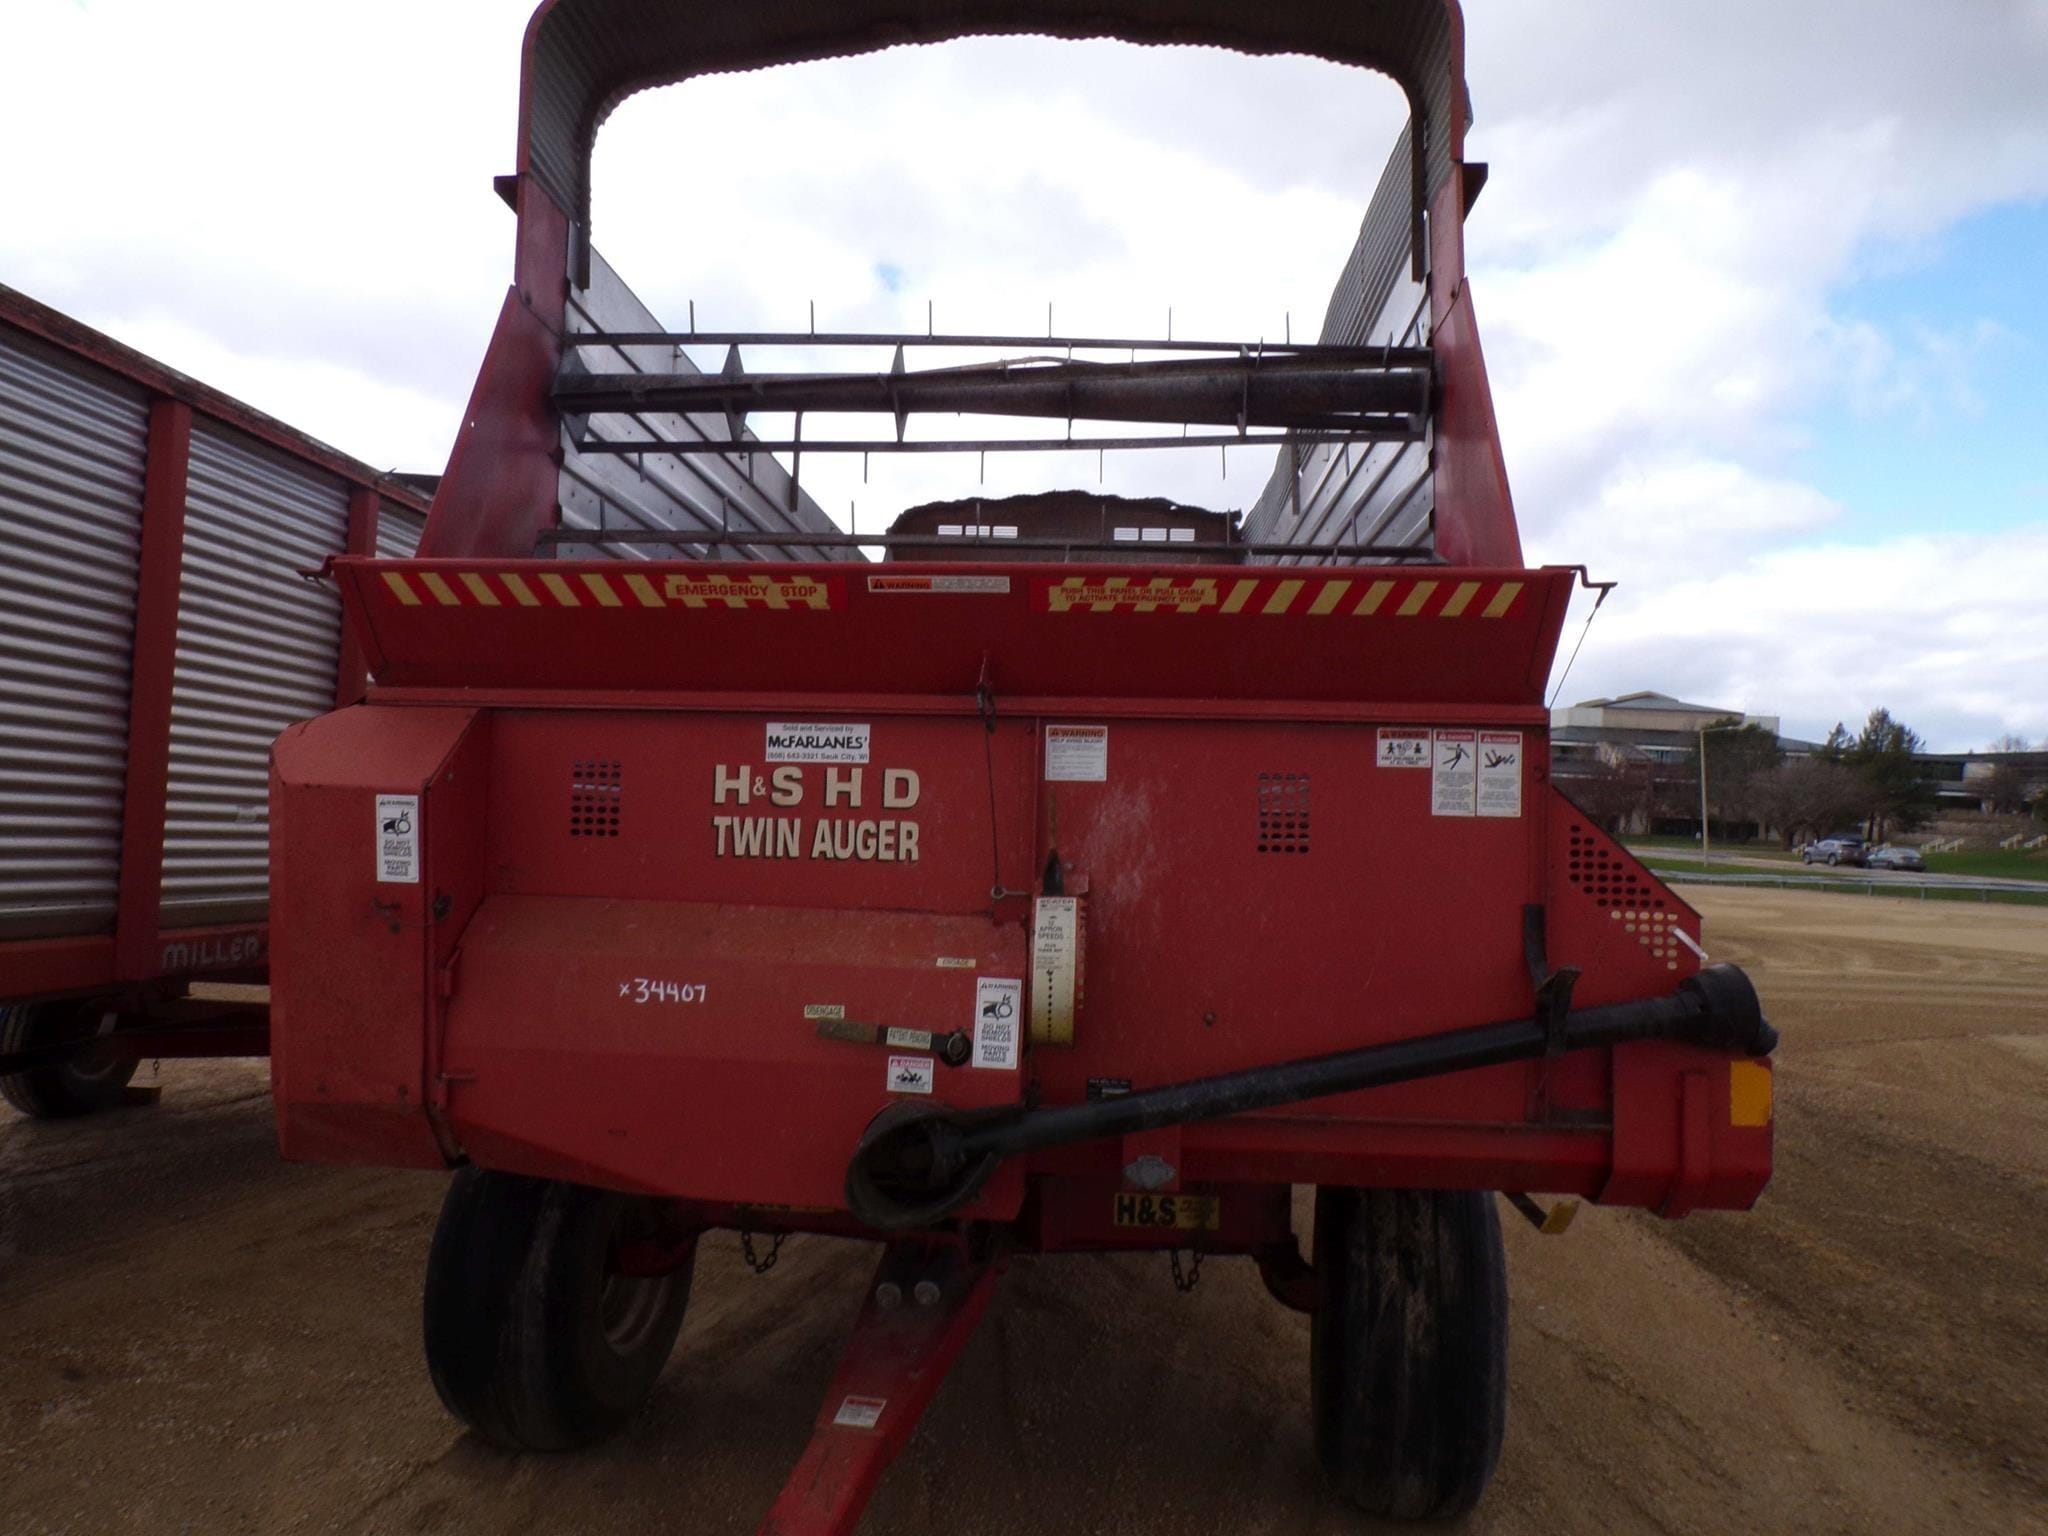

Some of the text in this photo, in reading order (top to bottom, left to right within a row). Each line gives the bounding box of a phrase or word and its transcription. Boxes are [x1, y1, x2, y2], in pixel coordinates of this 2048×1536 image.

[675, 584, 818, 598] EMERGENCY STOP
[1060, 728, 1105, 738] WARNING
[714, 764, 920, 809] H&S H D
[713, 816, 920, 861] TWIN AUGER
[162, 936, 259, 970] MILLER
[987, 982, 1018, 991] WARNING
[1117, 1194, 1177, 1226] H&S
